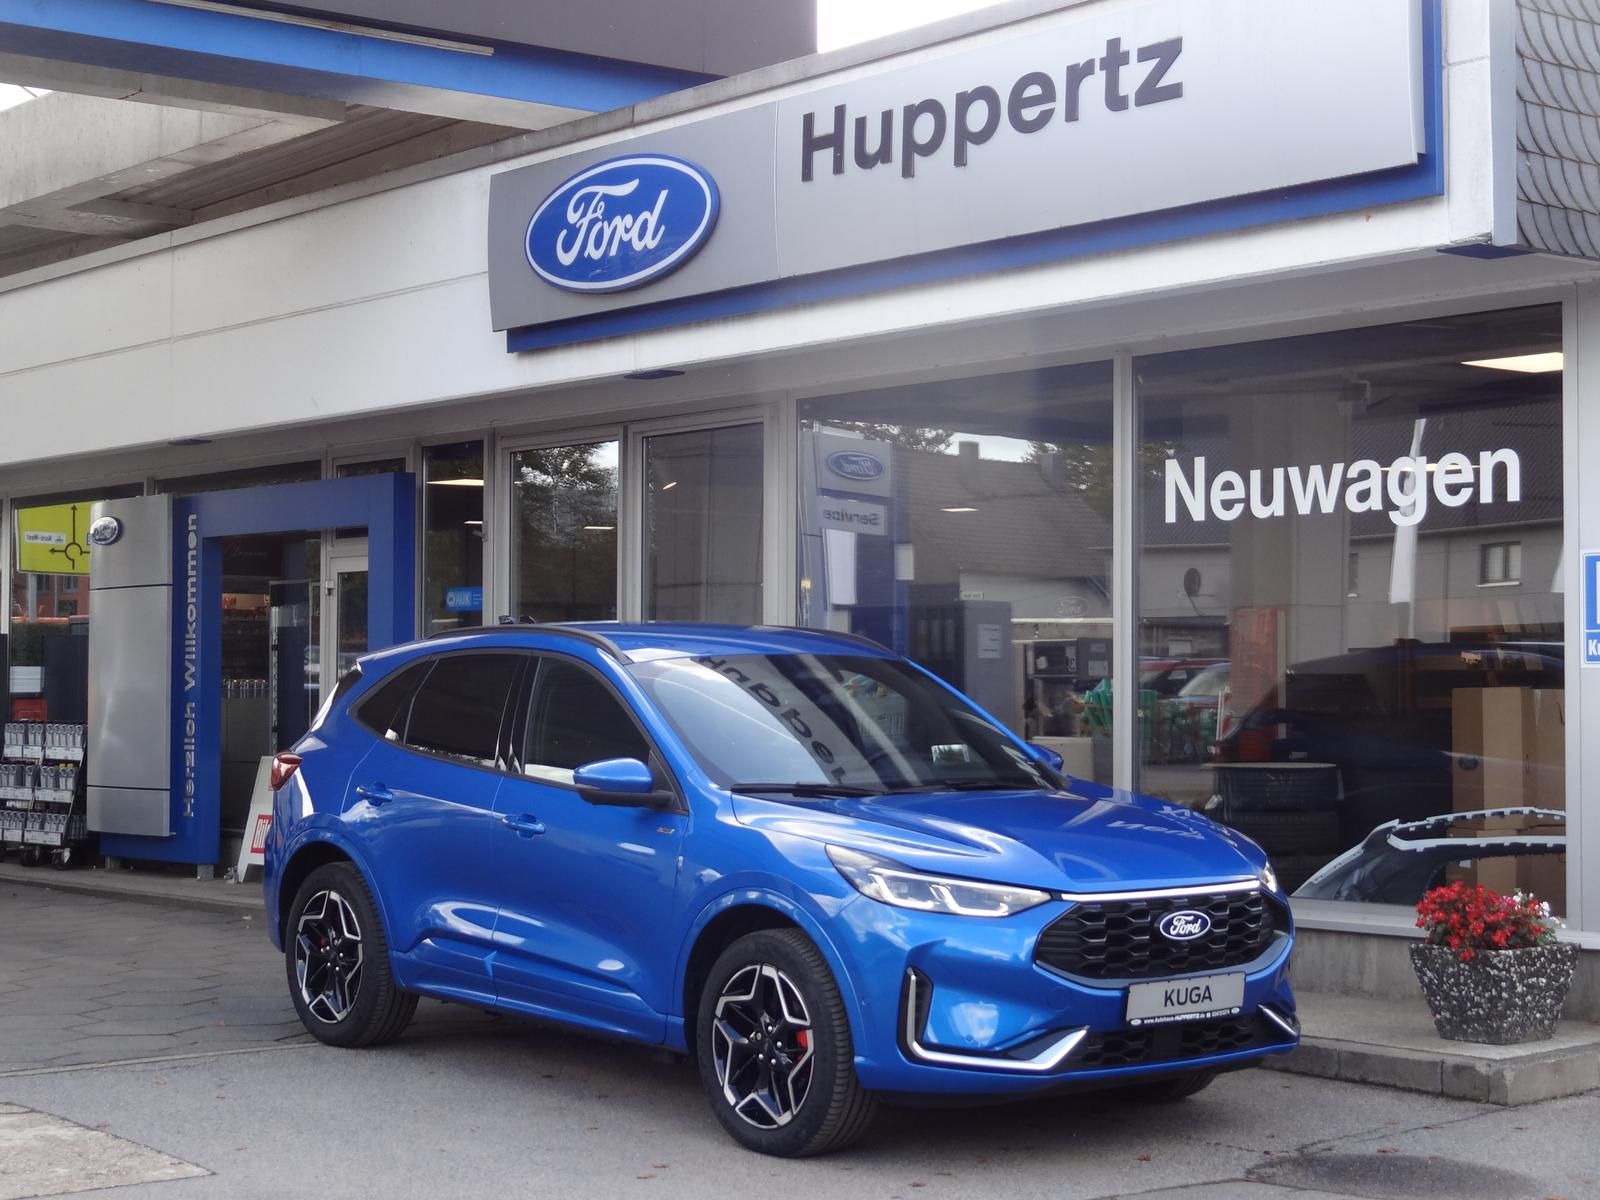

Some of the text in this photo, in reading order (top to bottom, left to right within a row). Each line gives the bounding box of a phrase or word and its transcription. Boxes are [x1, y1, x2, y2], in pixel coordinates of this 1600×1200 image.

[801, 35, 1184, 183] Huppertz
[555, 177, 669, 267] Ford
[1164, 447, 1521, 527] Neuwagen
[184, 513, 197, 818] Herzlich Willkommen
[1169, 915, 1201, 936] Ford
[1163, 984, 1213, 1008] KUGA
